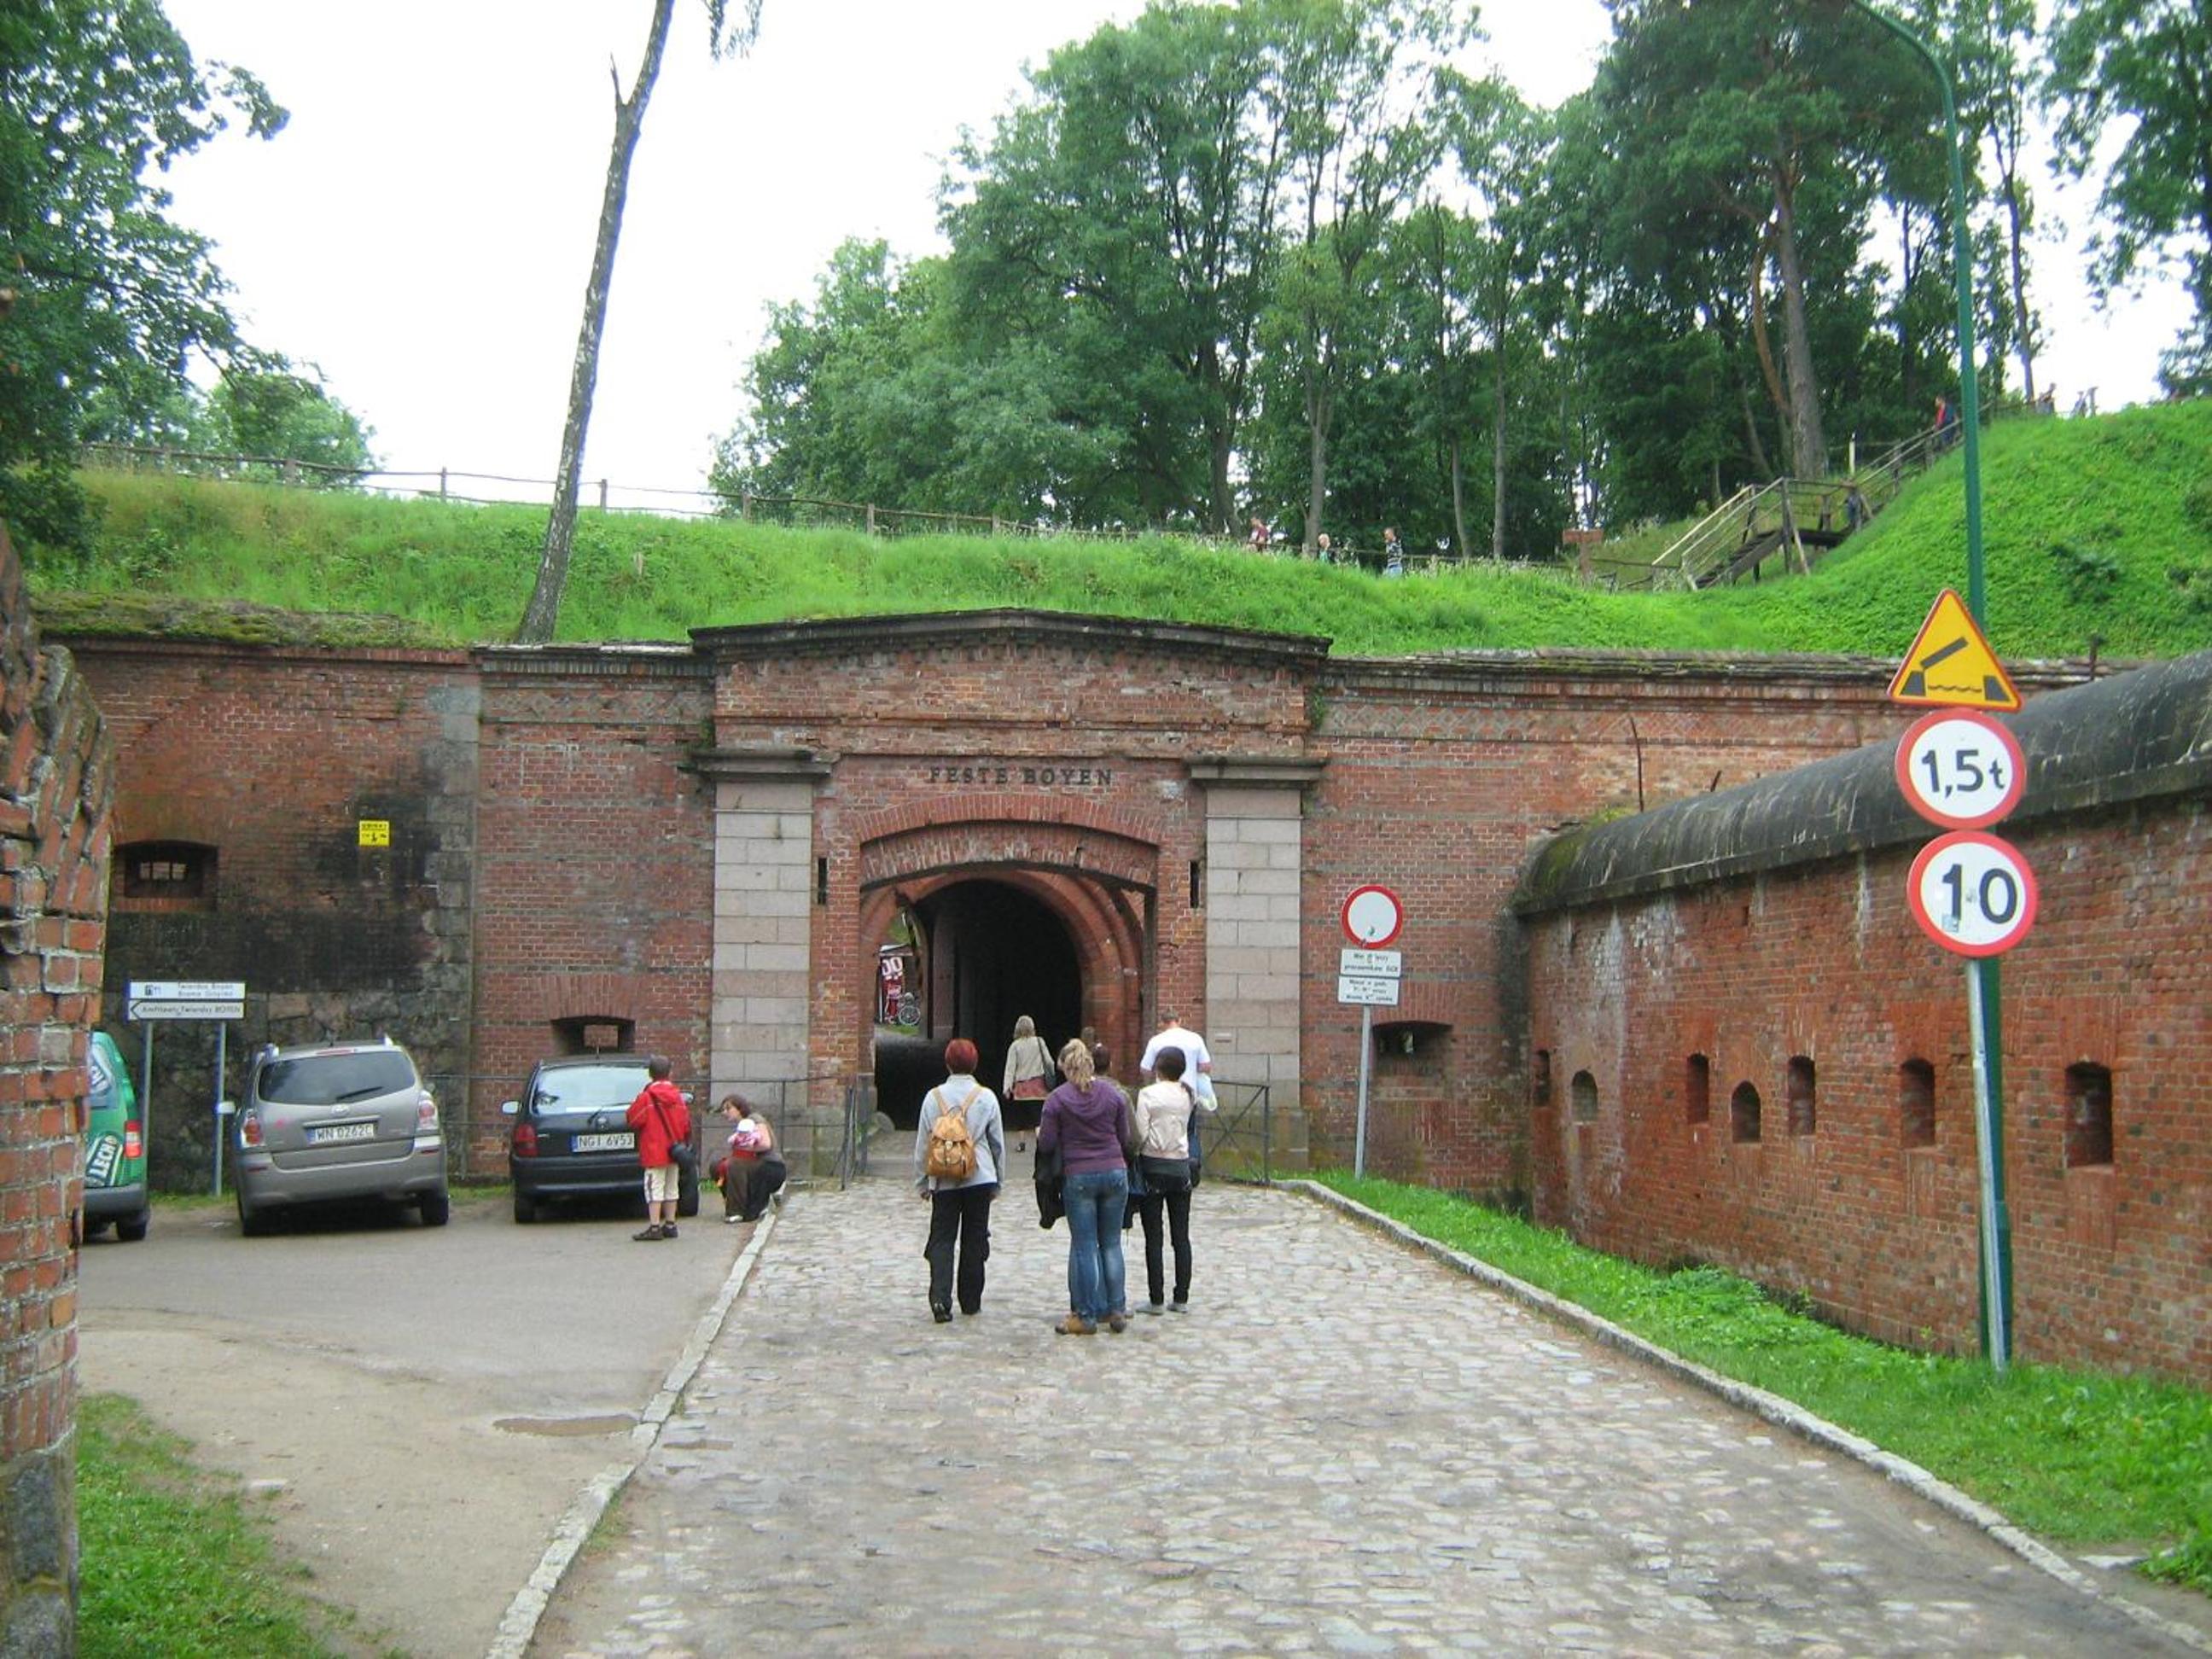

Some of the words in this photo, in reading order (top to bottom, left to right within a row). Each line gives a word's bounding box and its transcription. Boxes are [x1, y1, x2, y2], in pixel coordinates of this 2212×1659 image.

[928, 766, 1009, 784] FESTE
[1023, 768, 1113, 785] BOYEN
[1941, 863, 2018, 925] 10
[87, 1142, 117, 1179] LECH
